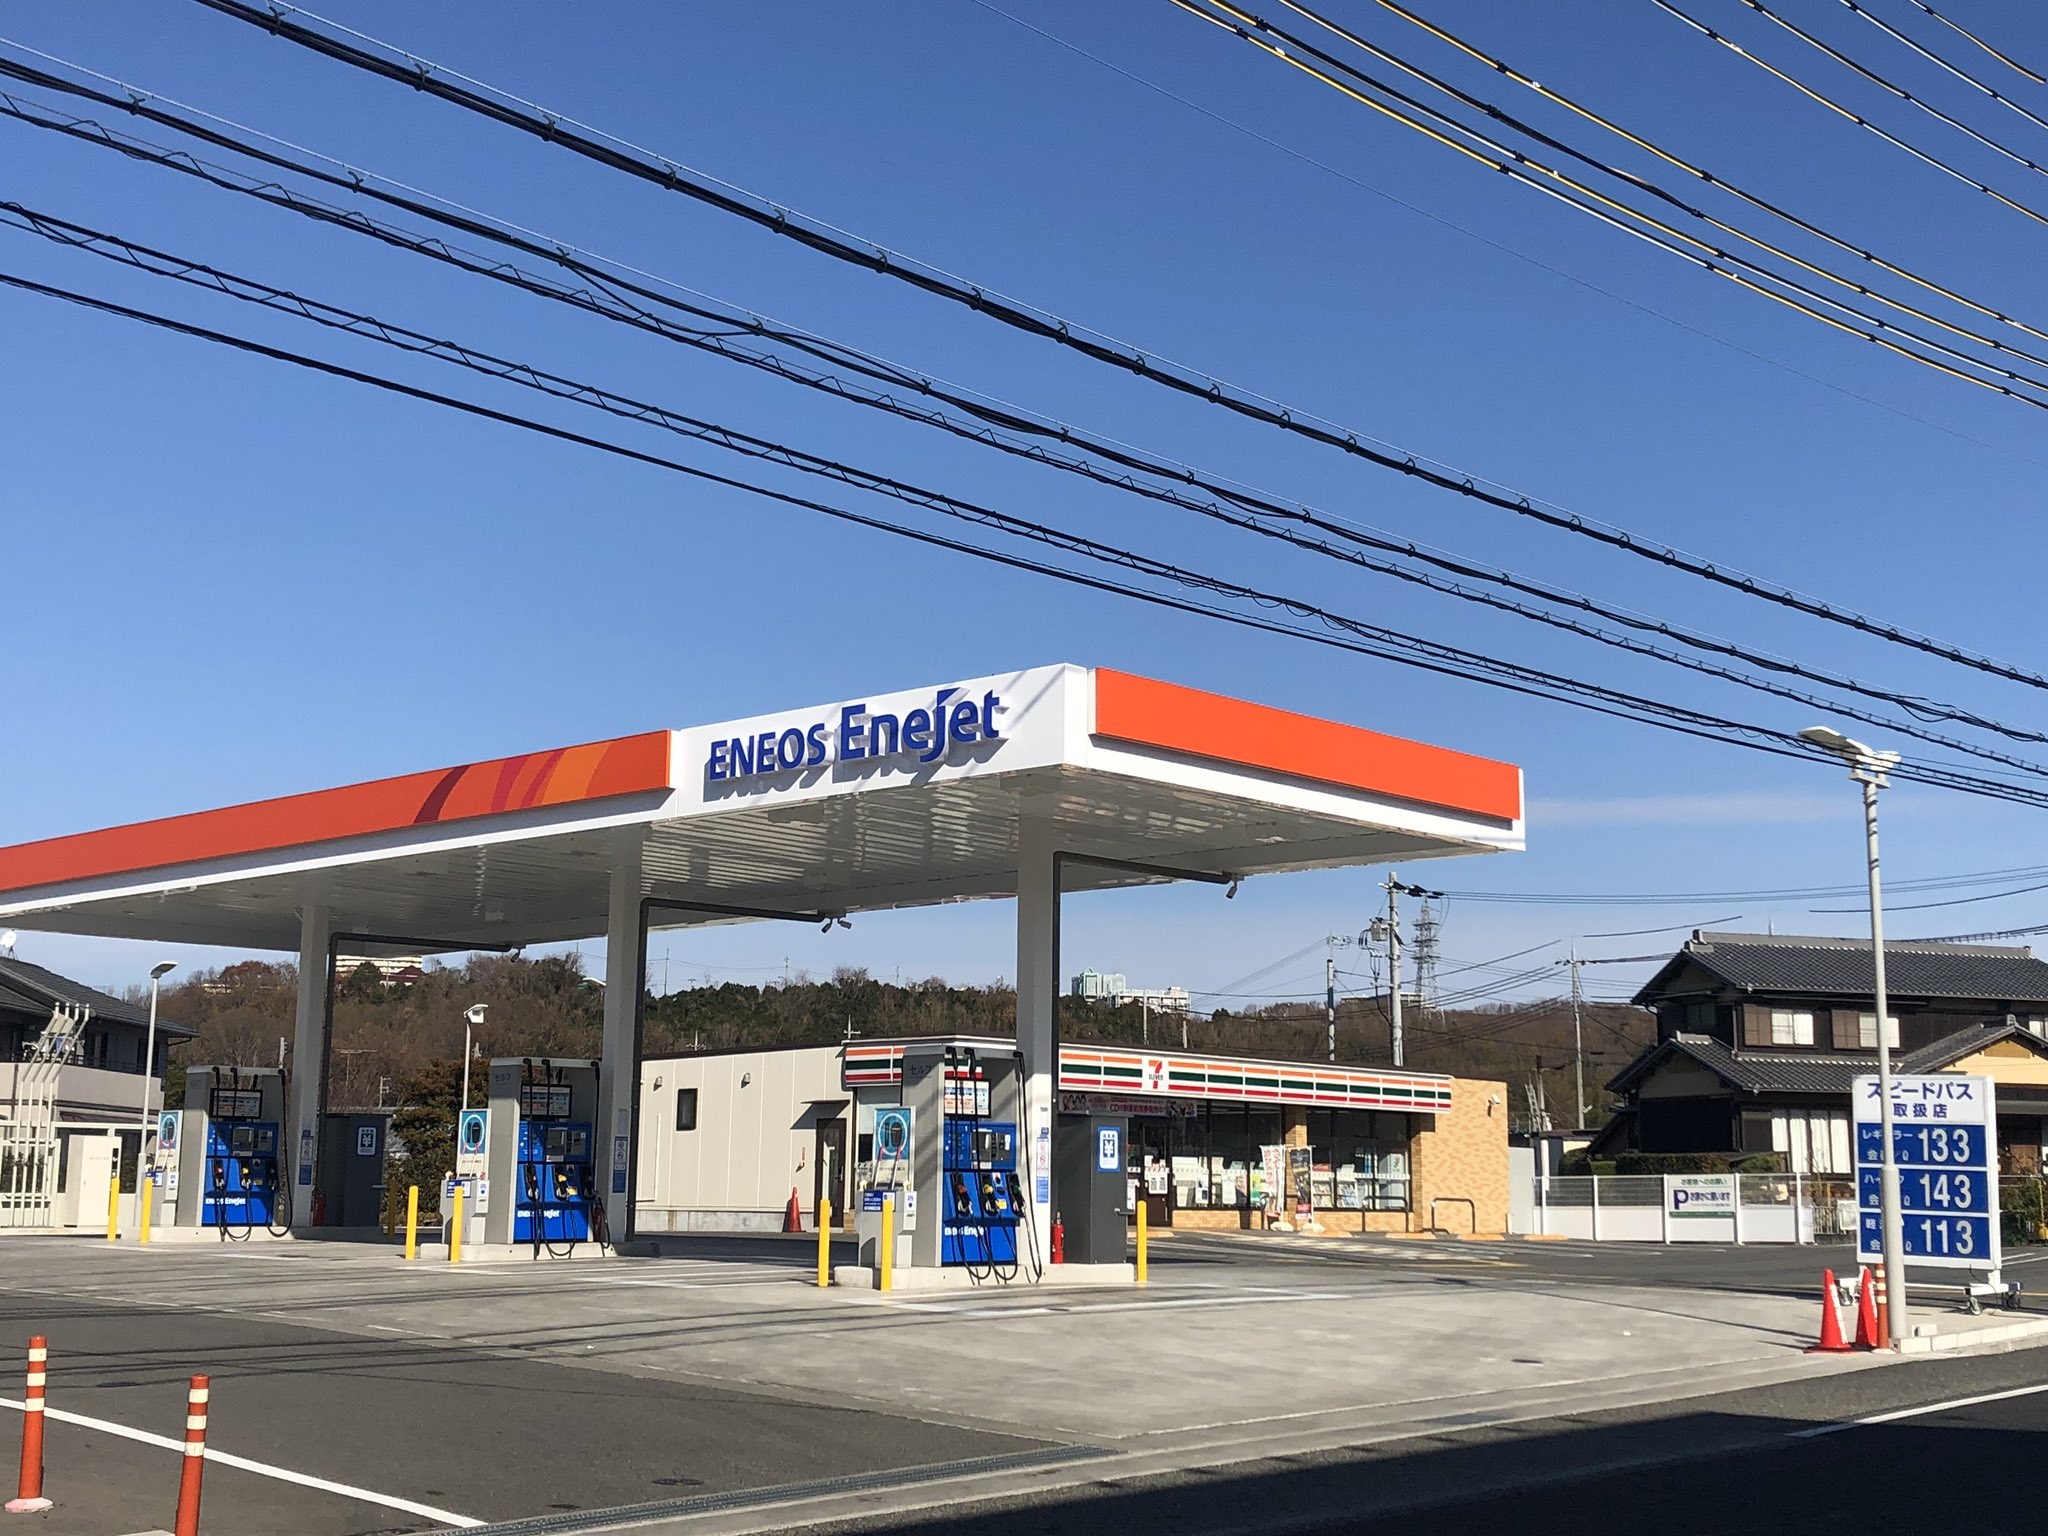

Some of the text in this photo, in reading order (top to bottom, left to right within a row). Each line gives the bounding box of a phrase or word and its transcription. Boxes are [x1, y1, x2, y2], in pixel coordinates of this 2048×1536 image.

[709, 687, 1000, 780] ENEOS Enejet
[1867, 1082, 1974, 1100] スピードパス
[1893, 1103, 1948, 1118] 取扱店
[1862, 1129, 1914, 1140] レギラー
[1918, 1128, 1970, 1162] 133
[1673, 1189, 1689, 1210] P
[1919, 1173, 1972, 1208] 143
[1920, 1219, 1973, 1255] 113
